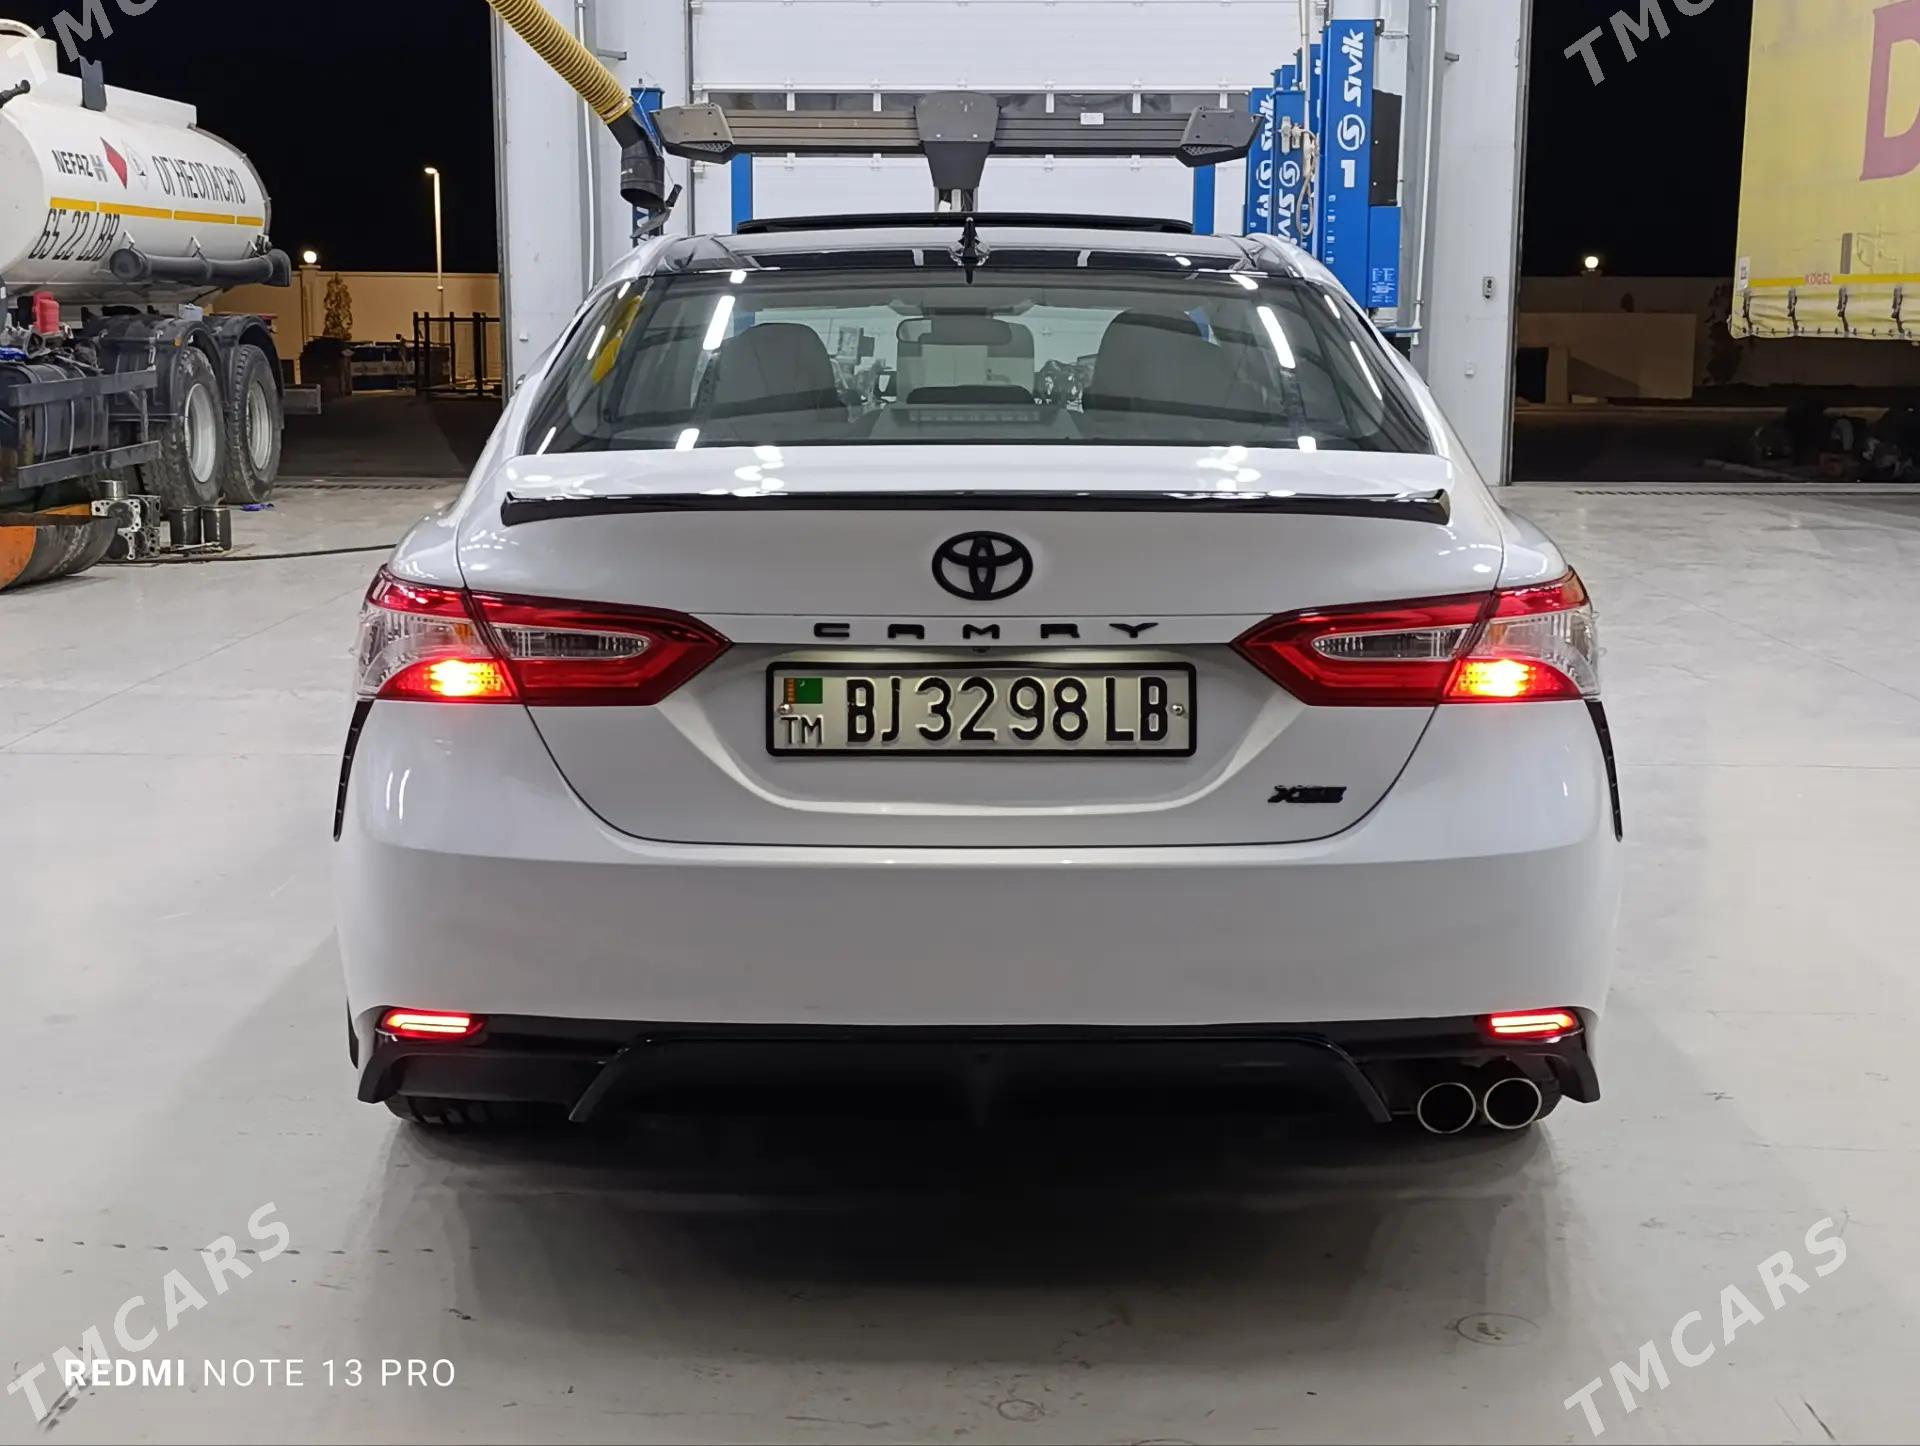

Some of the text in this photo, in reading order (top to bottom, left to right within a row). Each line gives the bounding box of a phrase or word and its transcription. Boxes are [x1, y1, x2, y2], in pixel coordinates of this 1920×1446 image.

[51, 149, 94, 177] NEFAZ
[813, 621, 1158, 639] CAMRY
[780, 715, 824, 745] TM
